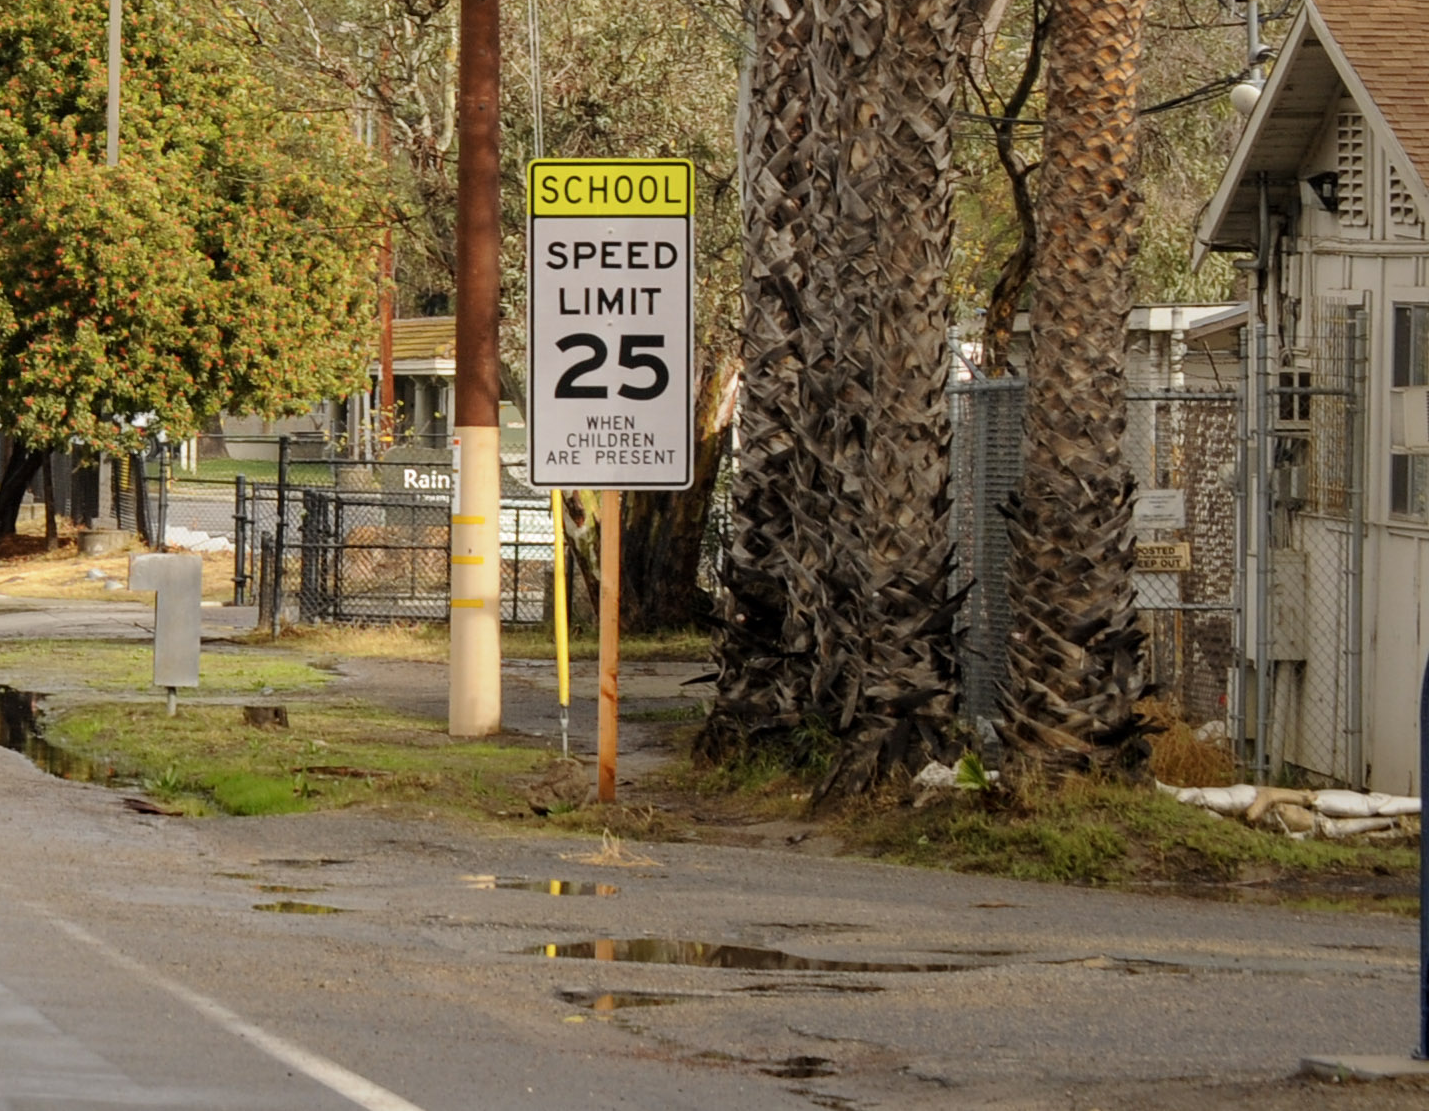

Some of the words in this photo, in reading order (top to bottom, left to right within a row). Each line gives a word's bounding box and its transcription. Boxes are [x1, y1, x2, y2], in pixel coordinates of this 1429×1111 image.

[540, 175, 682, 204] SCHOOL
[545, 240, 678, 270] SPEED
[558, 287, 662, 316] LIMIT
[554, 332, 670, 401] 25
[586, 415, 635, 431] WHEN
[566, 432, 655, 448] CHILDREN
[545, 449, 581, 465] ARE
[595, 449, 676, 465] PRESENT
[402, 468, 451, 489] Rain
[1137, 559, 1157, 568] EEP
[1161, 559, 1181, 568] OUT
